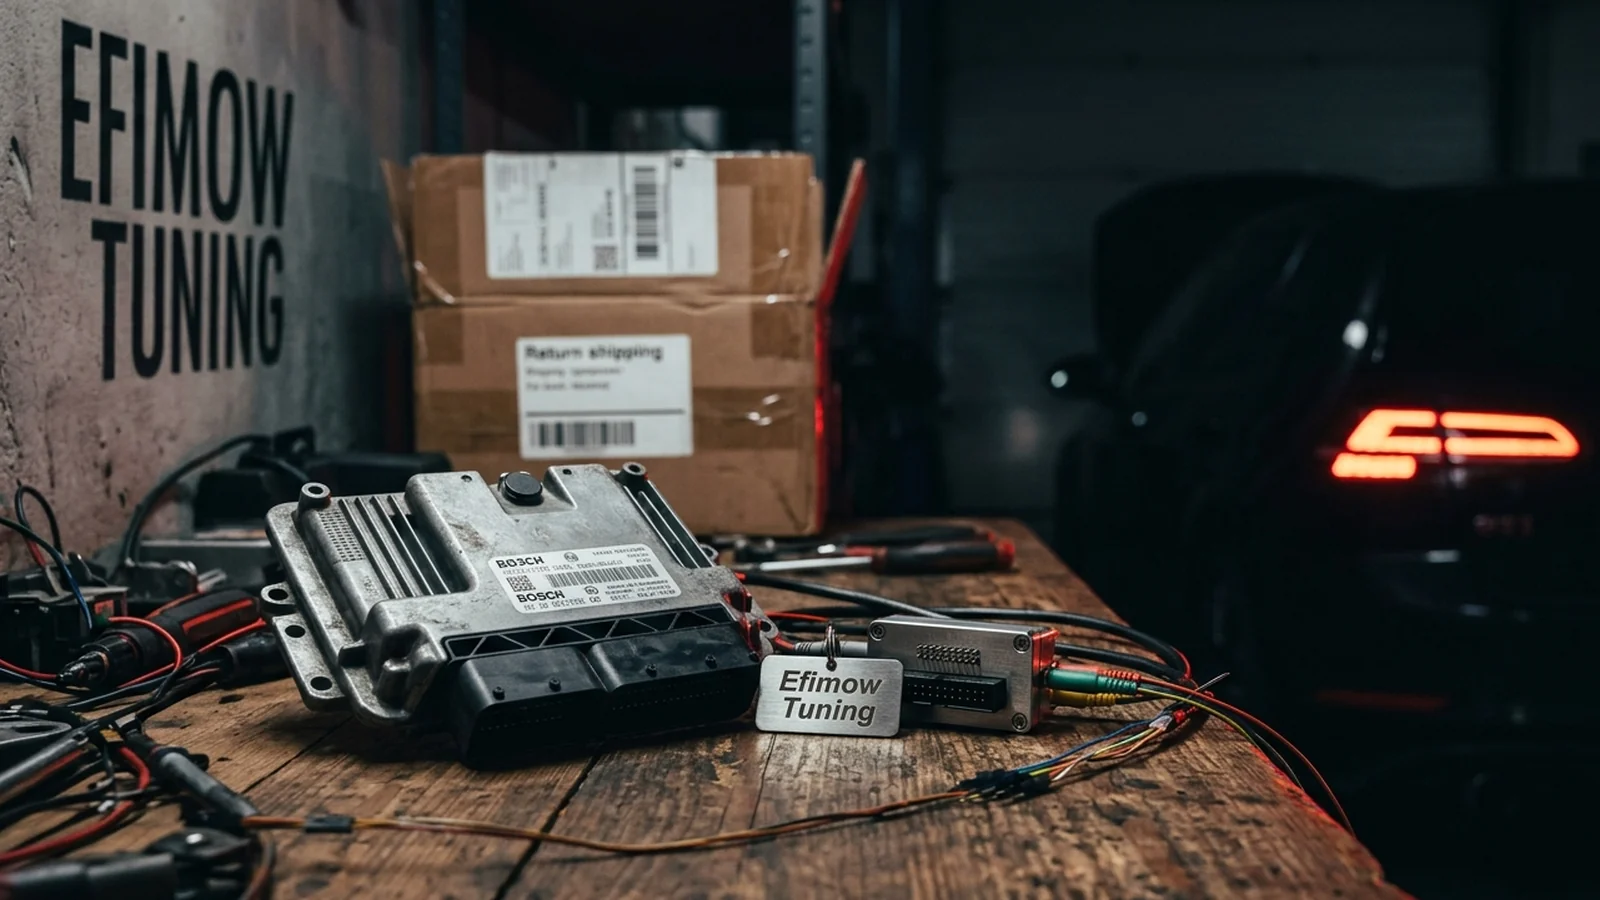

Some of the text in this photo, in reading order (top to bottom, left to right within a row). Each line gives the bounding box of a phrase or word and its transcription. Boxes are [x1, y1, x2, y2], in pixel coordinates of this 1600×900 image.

[61, 18, 294, 229] EFIMOW
[91, 219, 284, 381] TUNING
[589, 345, 664, 363] shipping
[516, 590, 566, 603] BOSCH
[779, 670, 883, 695] Efimow
[784, 697, 876, 727] Tuning
